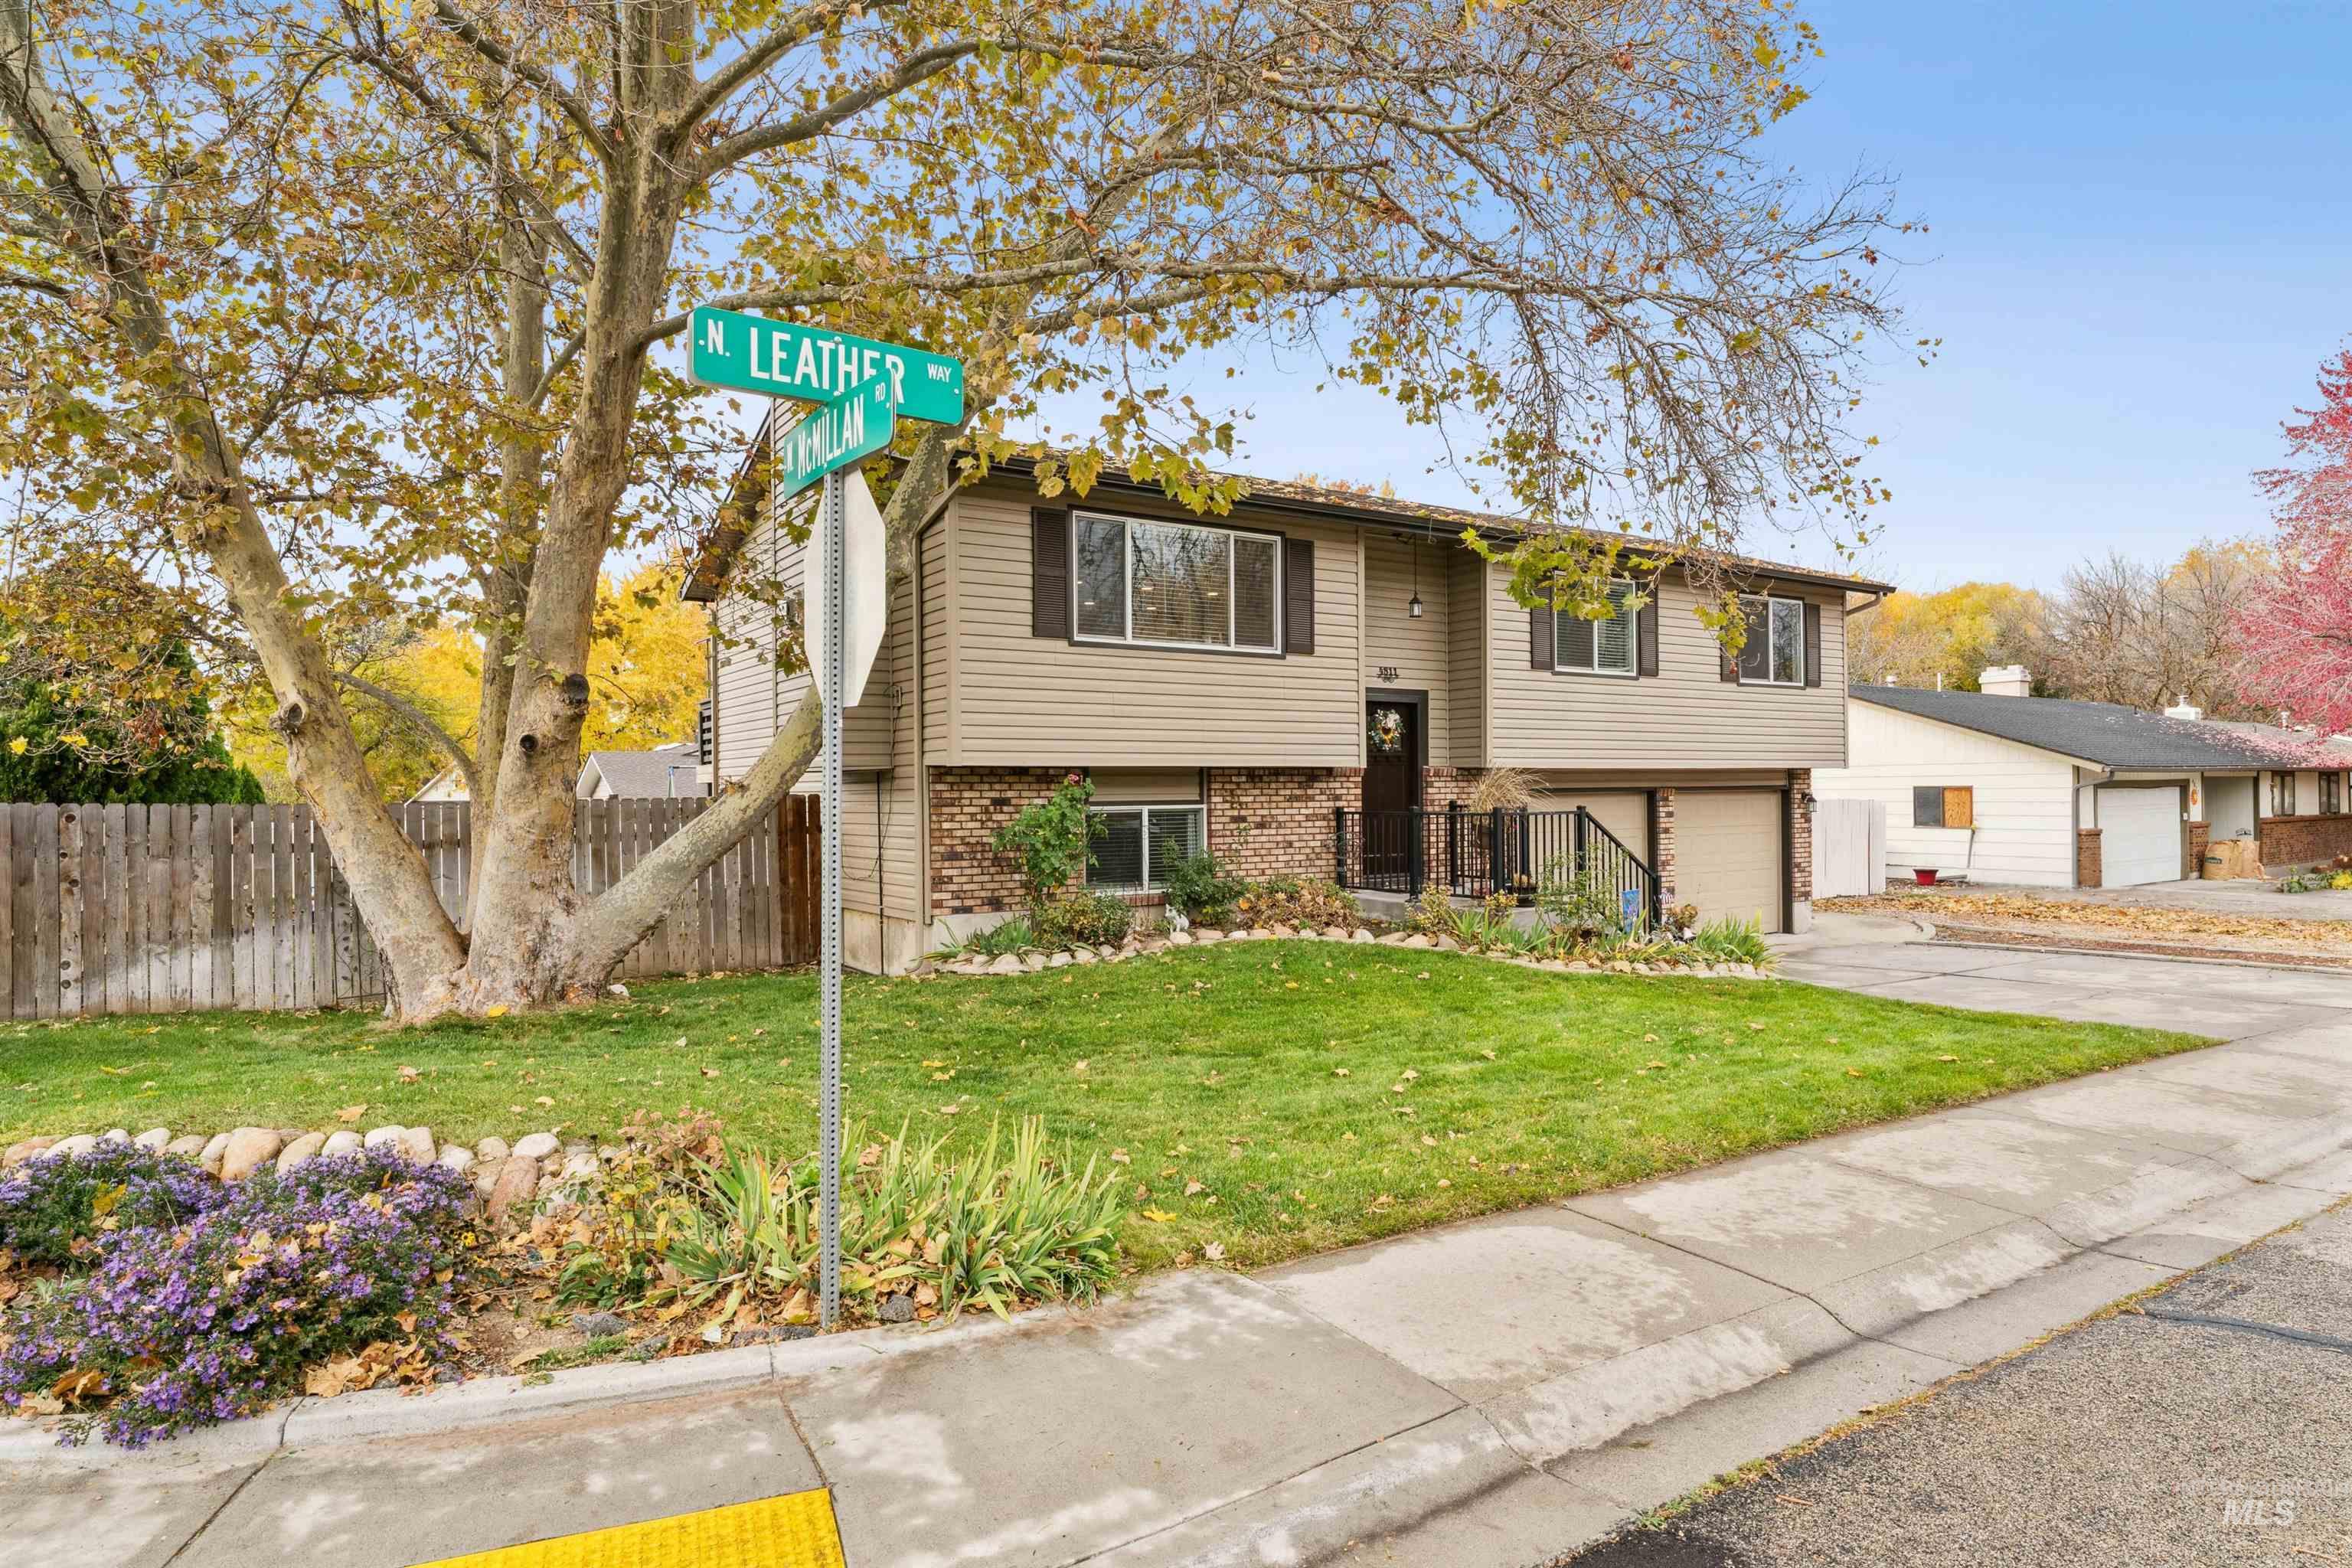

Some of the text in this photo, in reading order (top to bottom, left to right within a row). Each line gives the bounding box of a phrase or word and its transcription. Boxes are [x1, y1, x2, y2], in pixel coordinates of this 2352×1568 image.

[750, 327, 905, 404] LEATHER
[927, 363, 952, 383] WAY
[798, 393, 864, 480] McMILLAN
[875, 382, 886, 403] RD
